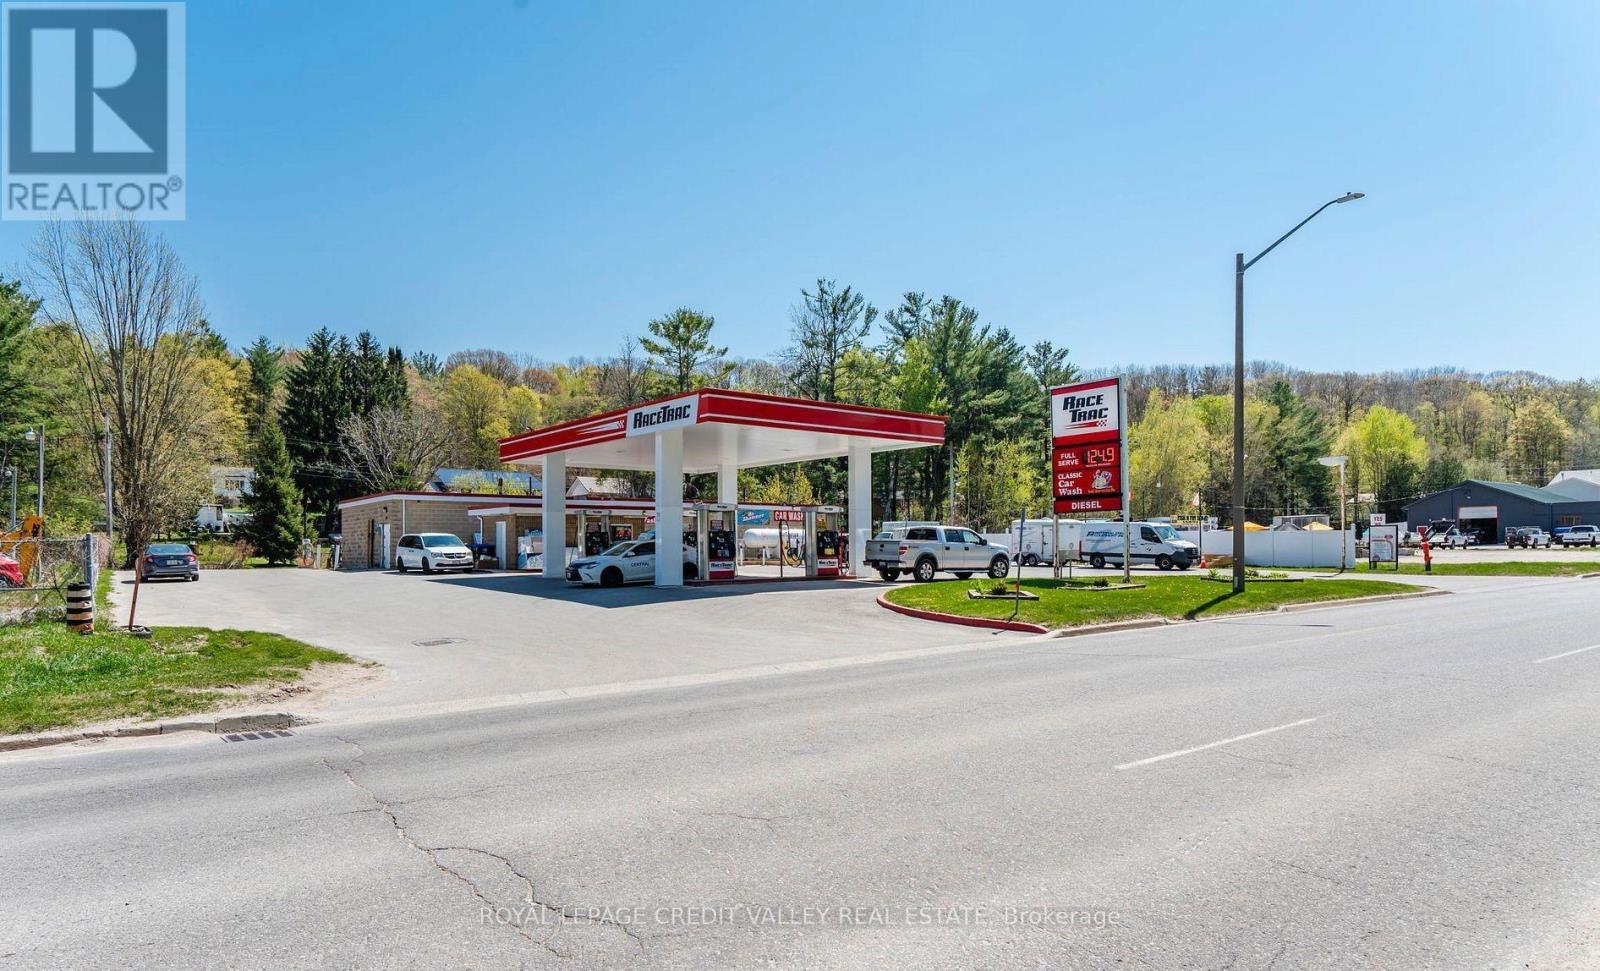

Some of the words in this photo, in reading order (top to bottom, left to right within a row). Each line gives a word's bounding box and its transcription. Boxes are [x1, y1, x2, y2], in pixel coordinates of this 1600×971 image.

[1058, 459, 1079, 467] SERVE
[1058, 472, 1083, 480] CLASSIC
[1058, 480, 1075, 488] Car
[1058, 487, 1082, 496] Wash
[1071, 500, 1102, 510] DIESEL
[775, 511, 787, 521] CAR
